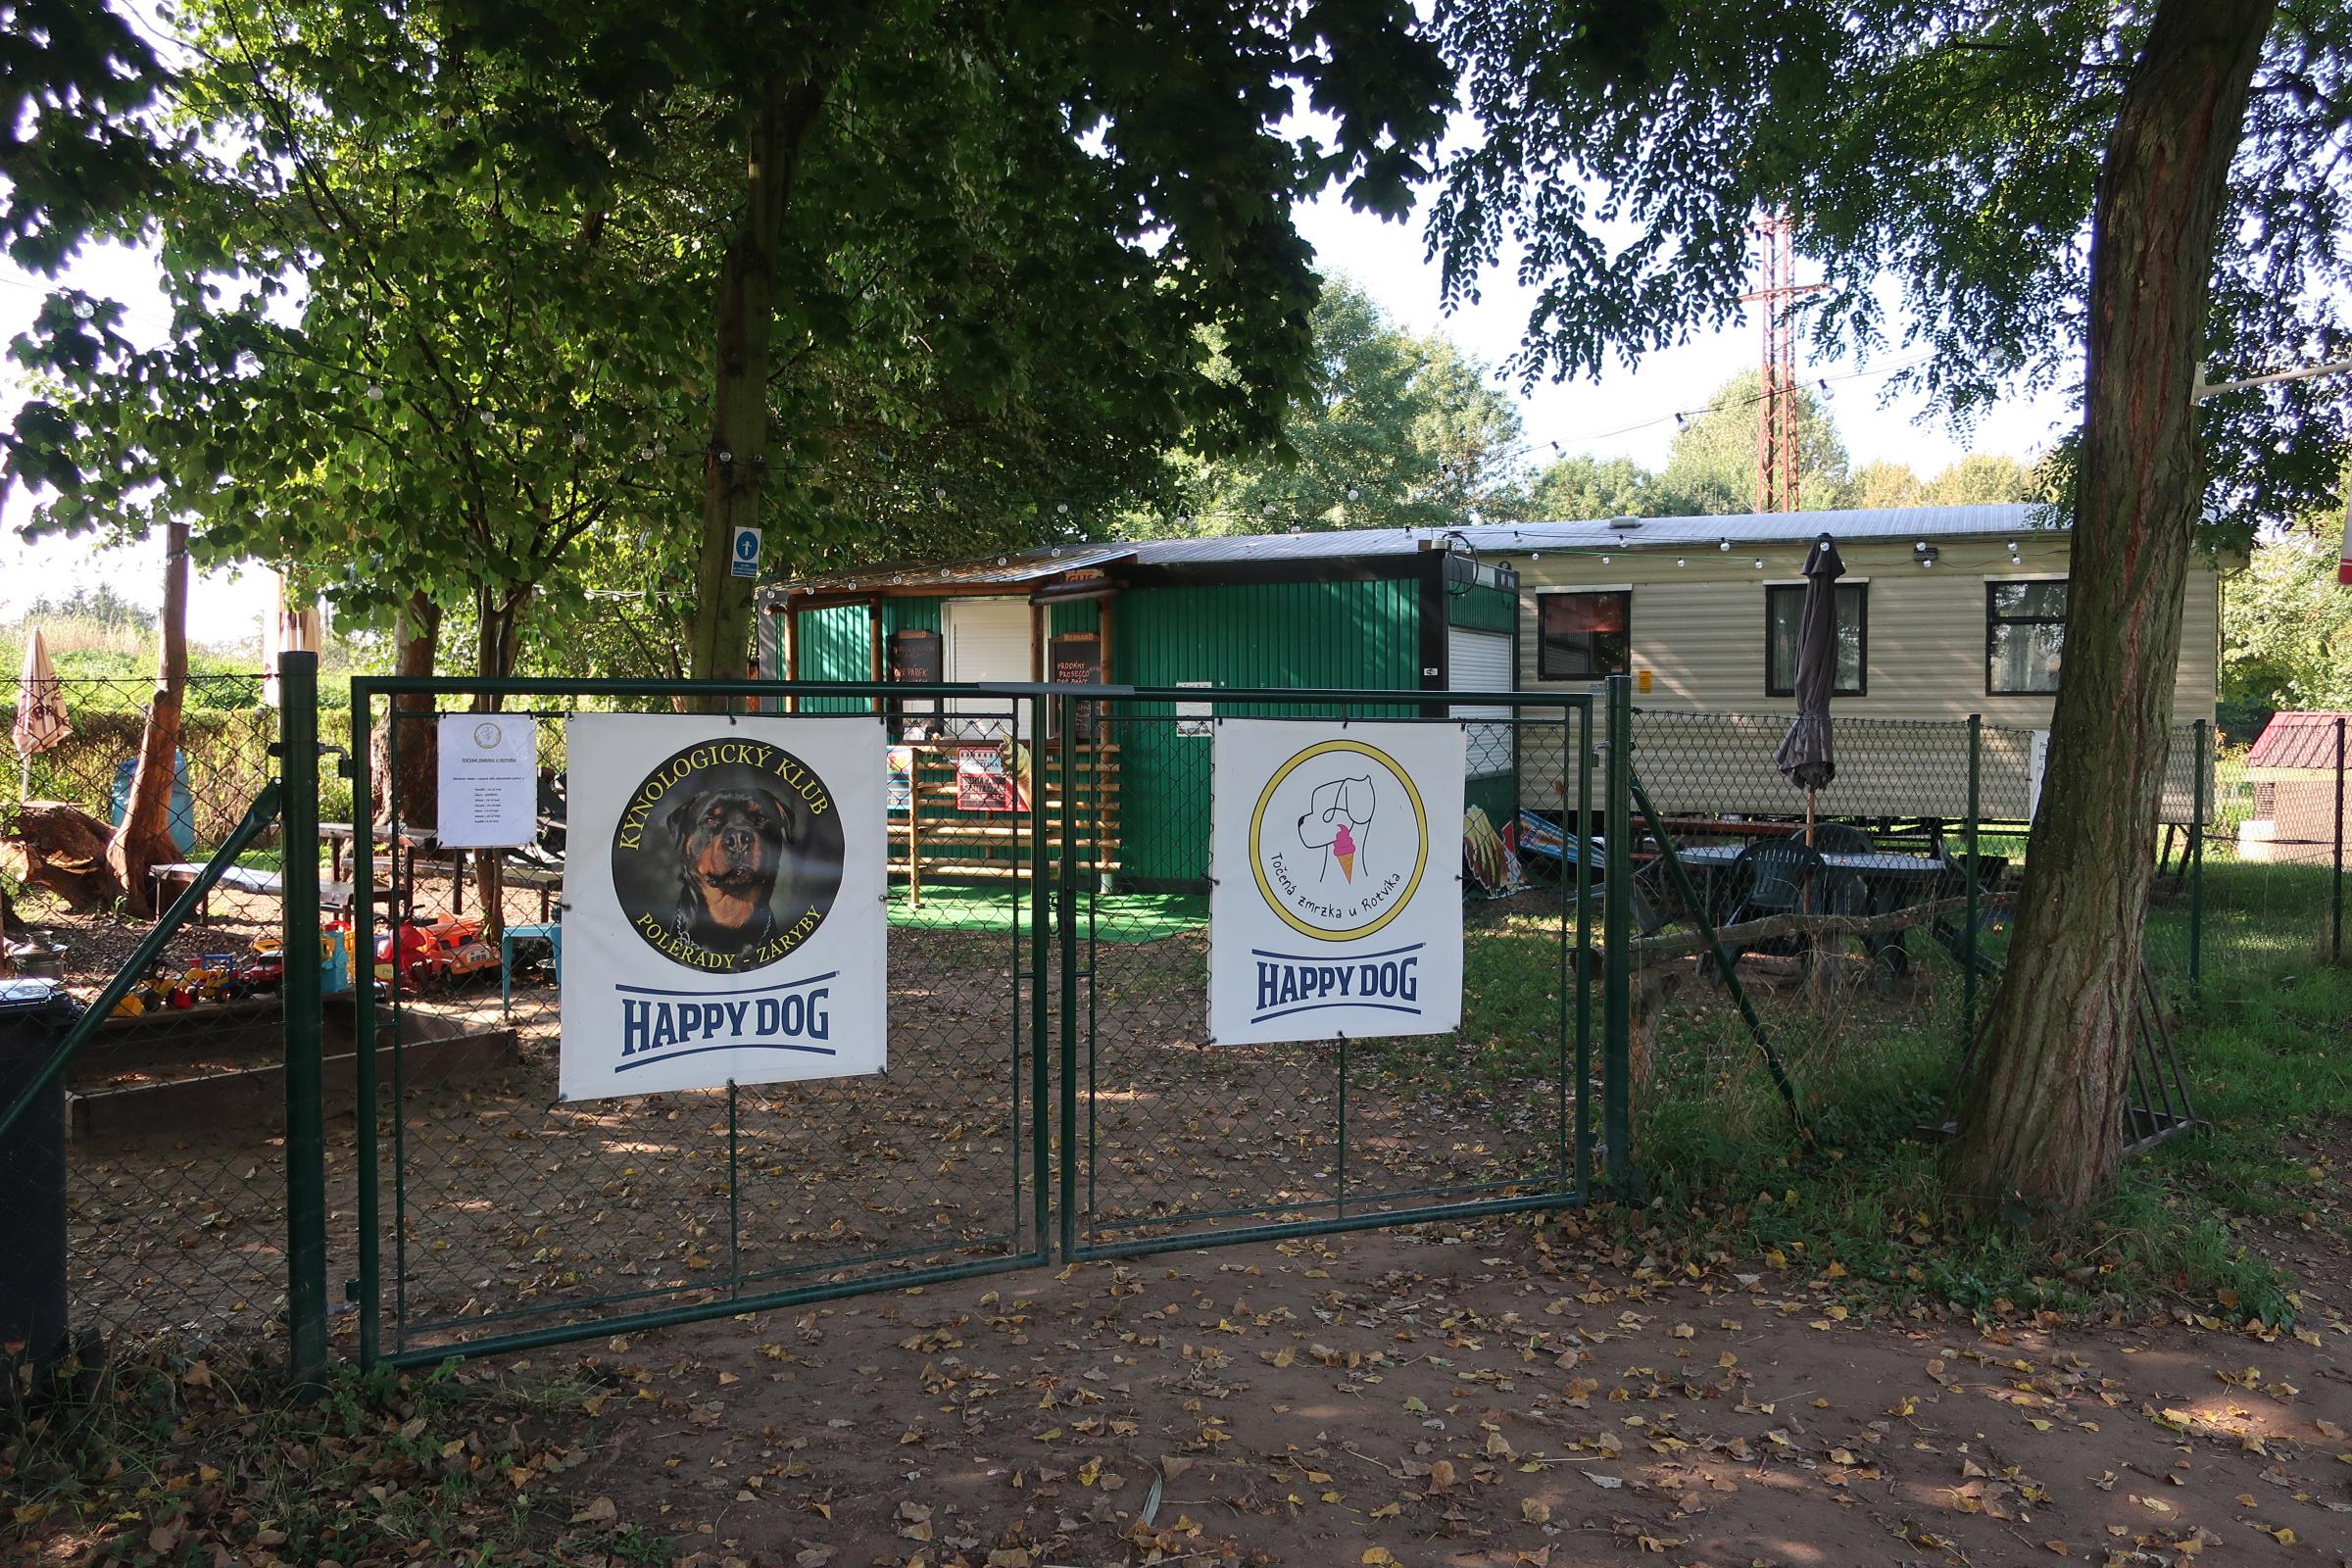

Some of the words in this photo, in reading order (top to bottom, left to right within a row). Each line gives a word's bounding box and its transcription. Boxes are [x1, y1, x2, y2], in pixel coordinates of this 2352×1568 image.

[619, 744, 772, 851] KYNOLOGICKÝ
[774, 758, 828, 815] KLUB
[1271, 852, 1297, 896] Točená
[1298, 896, 1342, 918] zmrzka
[1348, 907, 1357, 916] u
[1361, 873, 1400, 911] Rotvíka
[636, 912, 736, 968] POLERADY
[757, 905, 822, 963] ZÁRYBY
[1255, 961, 1355, 1010] HAPPY
[1359, 956, 1417, 1002] DOG
[621, 999, 750, 1056] HAPPY
[756, 988, 829, 1040] DOG
